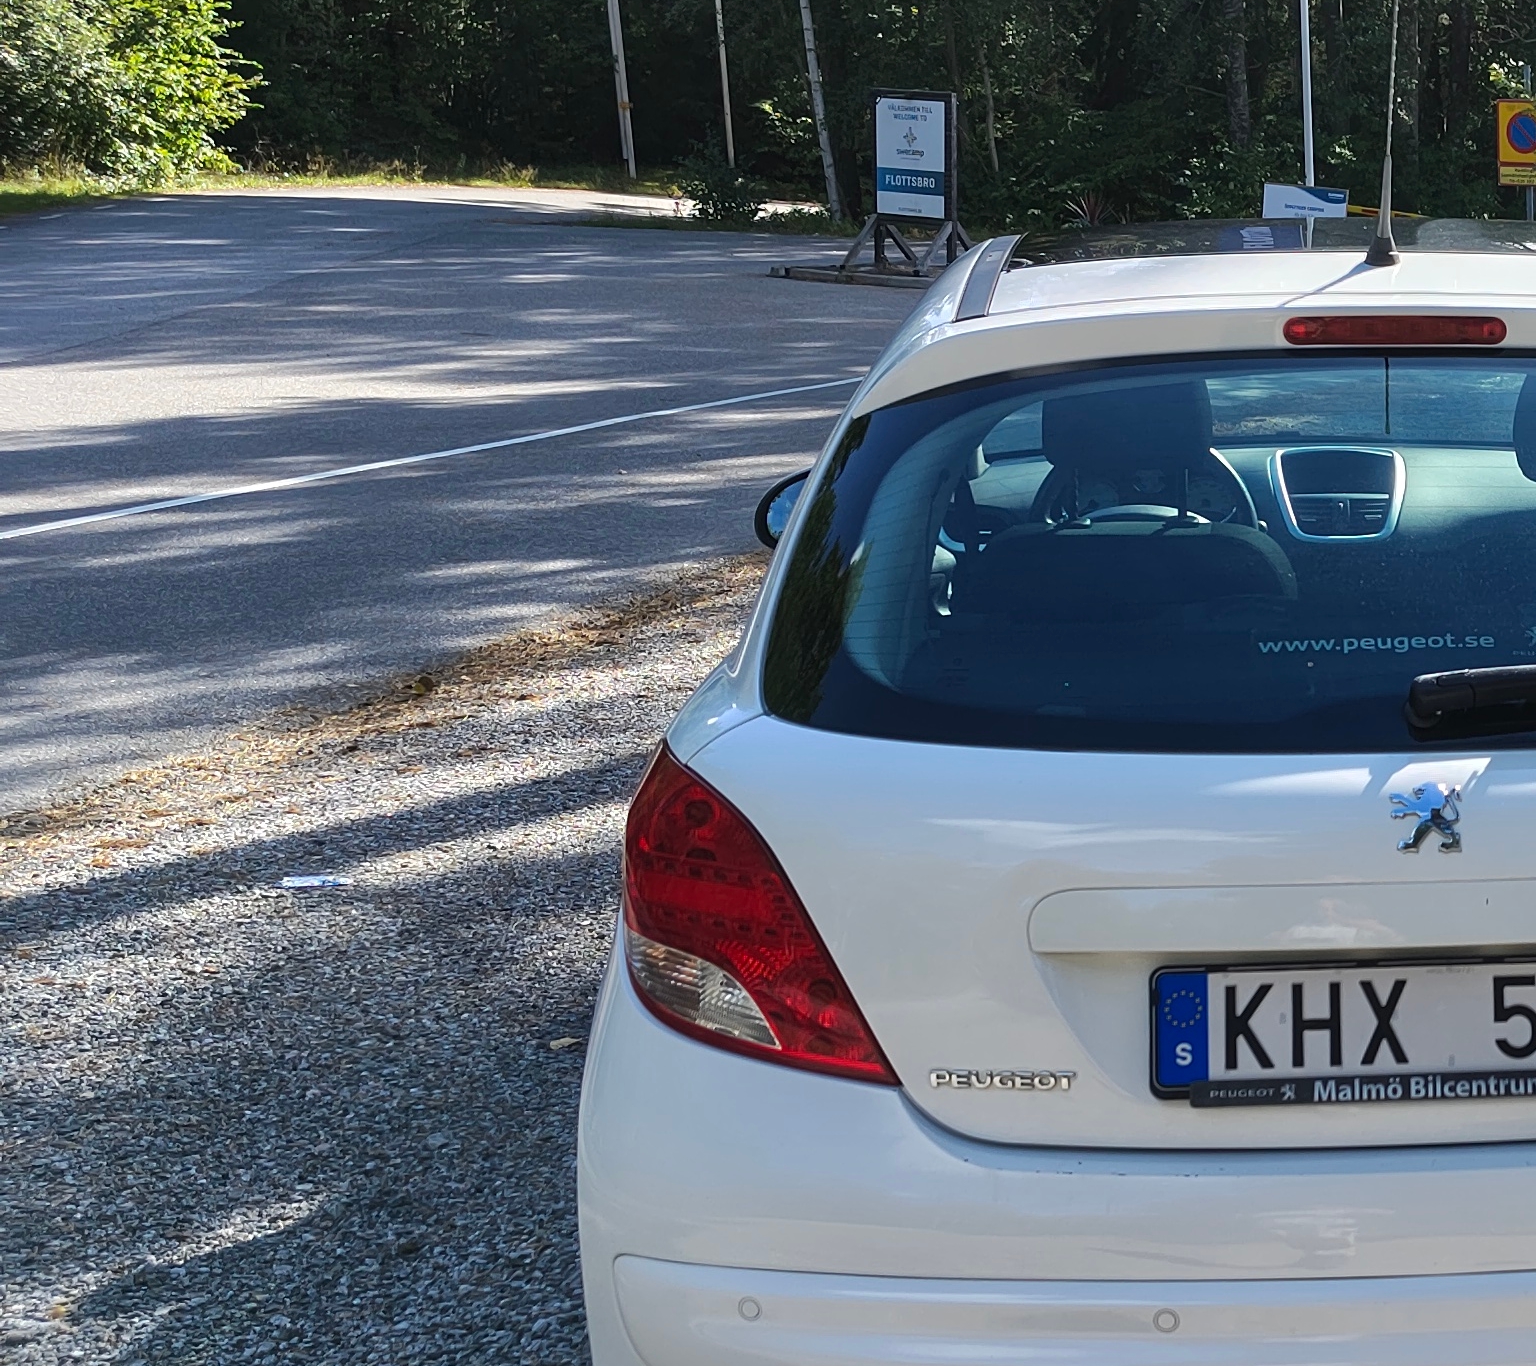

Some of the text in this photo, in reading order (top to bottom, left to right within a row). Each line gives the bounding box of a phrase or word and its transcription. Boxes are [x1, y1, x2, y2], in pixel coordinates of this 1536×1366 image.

[885, 174, 936, 189] FLOTTSBRO
[1258, 633, 1496, 653] www.peugeot.se
[1225, 978, 1409, 1070] KHX
[1175, 1042, 1193, 1066] S
[930, 1068, 1077, 1091] PEUGEOT
[1209, 1087, 1276, 1099] PEUGEOT
[1313, 1077, 1403, 1103] Malmö
